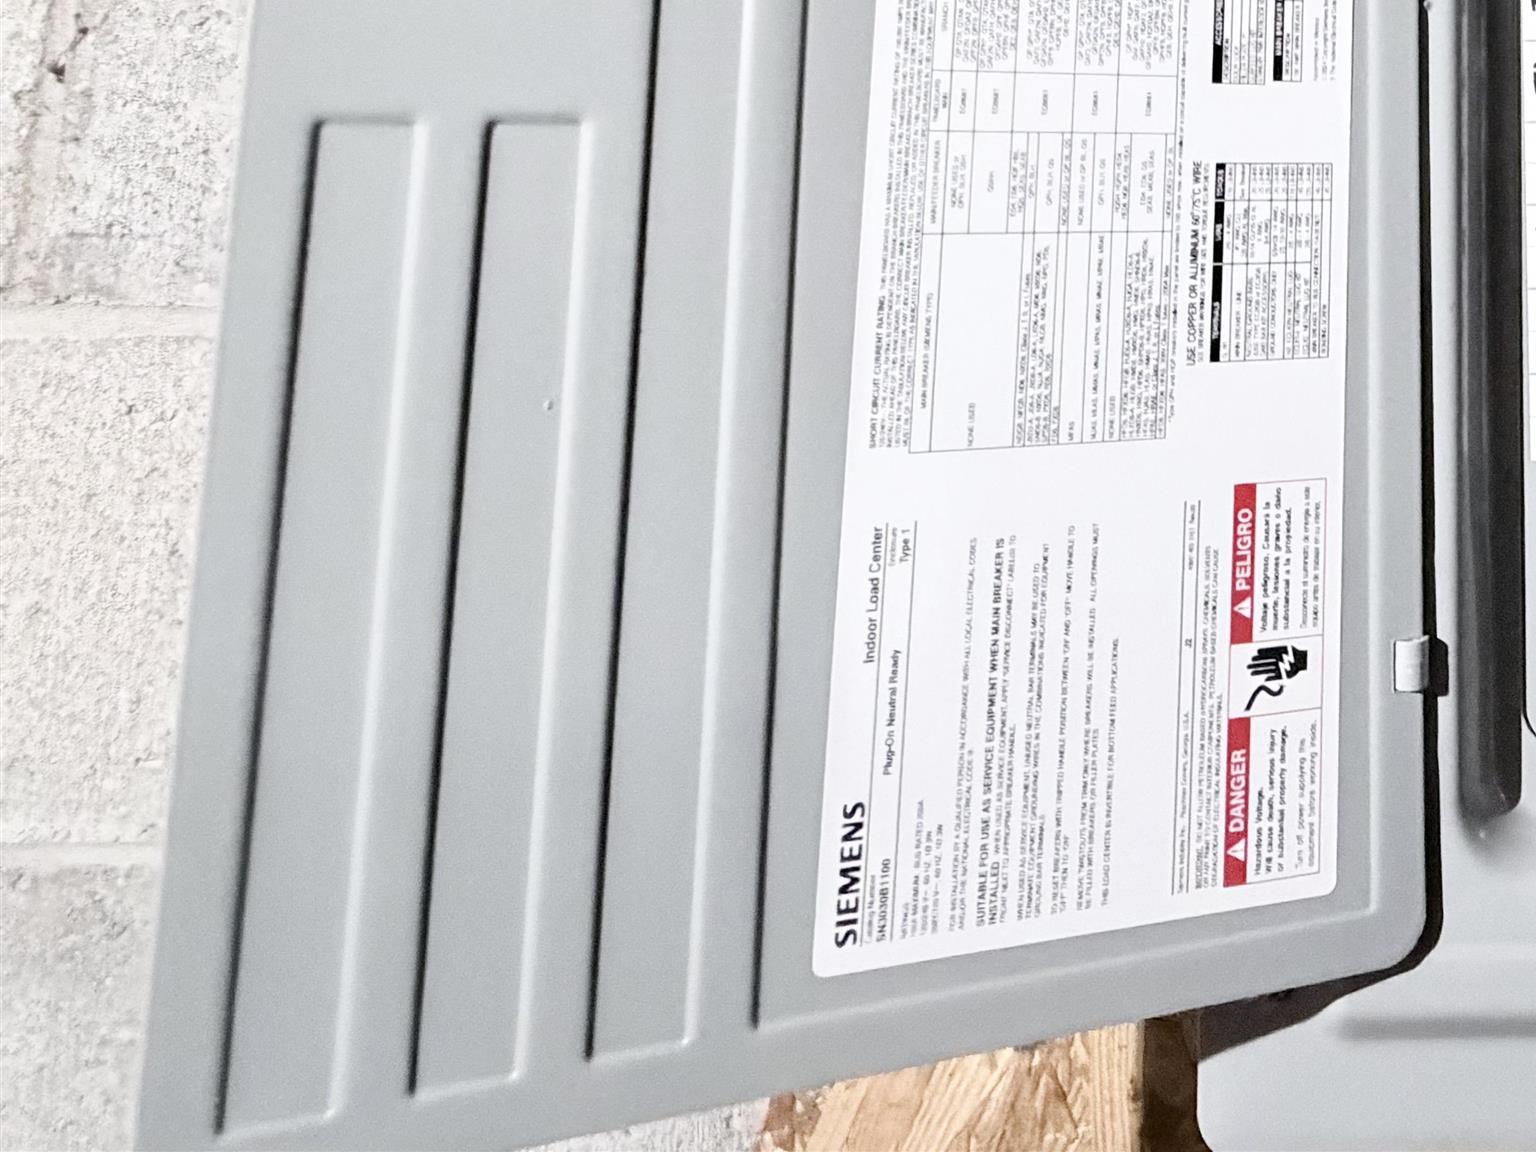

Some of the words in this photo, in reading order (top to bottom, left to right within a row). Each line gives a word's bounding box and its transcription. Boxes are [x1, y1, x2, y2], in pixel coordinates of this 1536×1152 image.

[1191, 160, 1202, 184] WIRE
[1188, 229, 1200, 280] ALUMINUM
[1187, 285, 1198, 298] OR
[1186, 302, 1197, 342] COPPER
[1185, 345, 1196, 366] USE
[1263, 501, 1270, 509] la
[1274, 486, 1283, 509] daño
[868, 525, 883, 573] Center
[899, 537, 912, 563] Type
[994, 537, 1005, 549] IS
[1235, 506, 1253, 591] PELIGRO
[1272, 522, 1282, 552] graves
[992, 550, 1004, 604] BREAKER
[1260, 552, 1270, 598] peligroso.
[1271, 555, 1281, 594] lesiones
[1283, 557, 1291, 566] la
[865, 576, 880, 612] Load
[1281, 578, 1290, 630] substancial
[990, 605, 1001, 635] MAIN
[1259, 602, 1269, 632] Voltaje
[1270, 596, 1280, 631] muerte,
[862, 616, 878, 664] Indoor
[988, 637, 1000, 673] WHEN
[887, 648, 901, 684] Ready
[885, 686, 899, 727] Neutral
[985, 675, 998, 742] EQUIPMENT
[882, 729, 897, 776] Plug-On
[1268, 727, 1278, 754] injury
[1278, 724, 1288, 764] damage.
[982, 744, 994, 795] SERVICE
[1267, 756, 1277, 790] serious
[1277, 767, 1287, 805] property
[981, 797, 992, 814] AS
[1228, 747, 1247, 833] DANGER
[1266, 793, 1276, 822] death,
[980, 815, 991, 840] USE
[1276, 808, 1285, 858] substantial
[978, 841, 990, 867] FOR
[1253, 826, 1262, 875] Hazardous
[1264, 855, 1274, 873] Will
[833, 800, 865, 949] SIEMENS
[975, 869, 988, 927] SUITABLE
